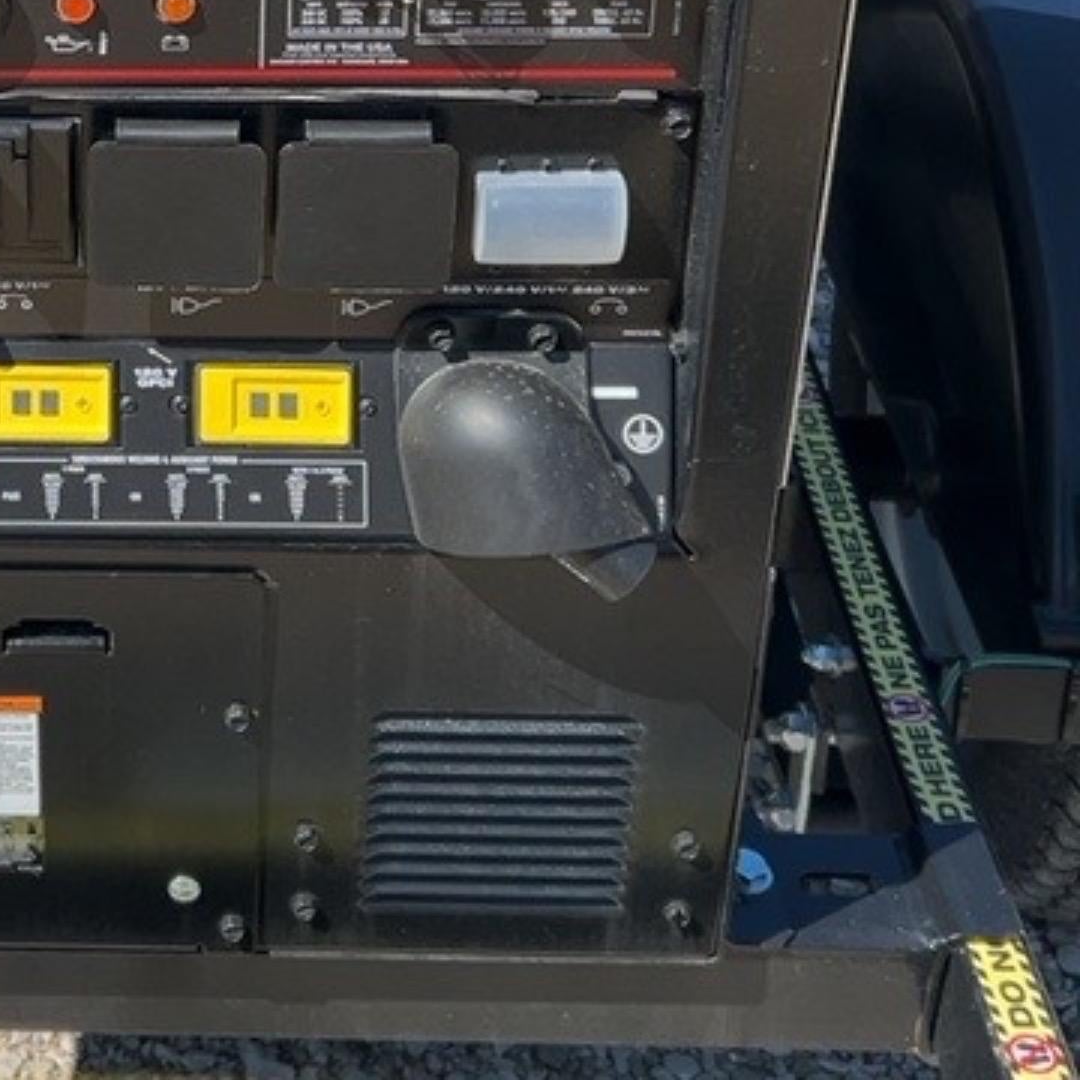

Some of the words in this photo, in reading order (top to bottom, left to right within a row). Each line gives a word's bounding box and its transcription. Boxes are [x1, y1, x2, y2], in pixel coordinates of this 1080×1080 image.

[807, 437, 852, 522] DEBOUT
[840, 526, 880, 598] TENEZ
[864, 603, 898, 650] PAS
[914, 726, 947, 796] HERE
[998, 980, 1036, 1028] DO
